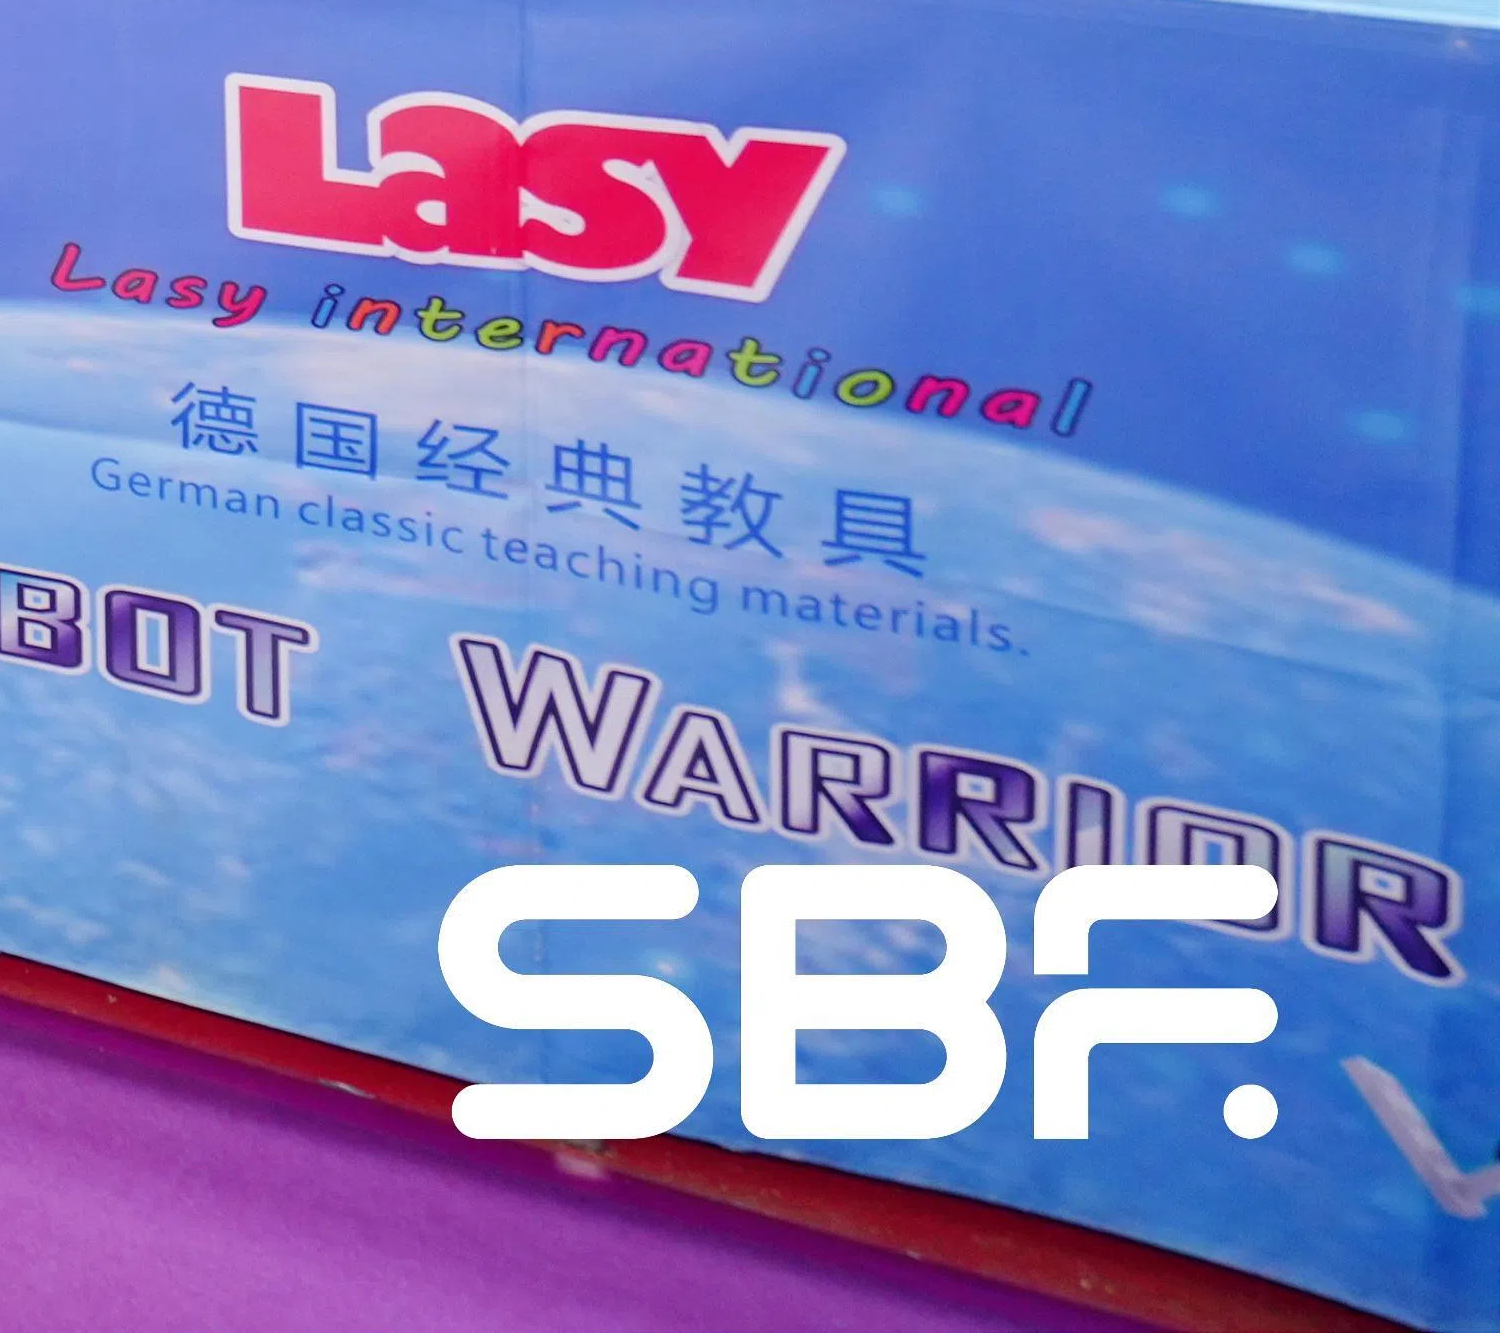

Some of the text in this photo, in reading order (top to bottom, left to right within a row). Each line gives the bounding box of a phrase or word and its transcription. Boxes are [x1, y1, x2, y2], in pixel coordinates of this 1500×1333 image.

[48, 242, 1094, 439] Lasy international
[90, 455, 1033, 659] German classic teaching materials.
[169, 378, 929, 580] 德国经典教具
